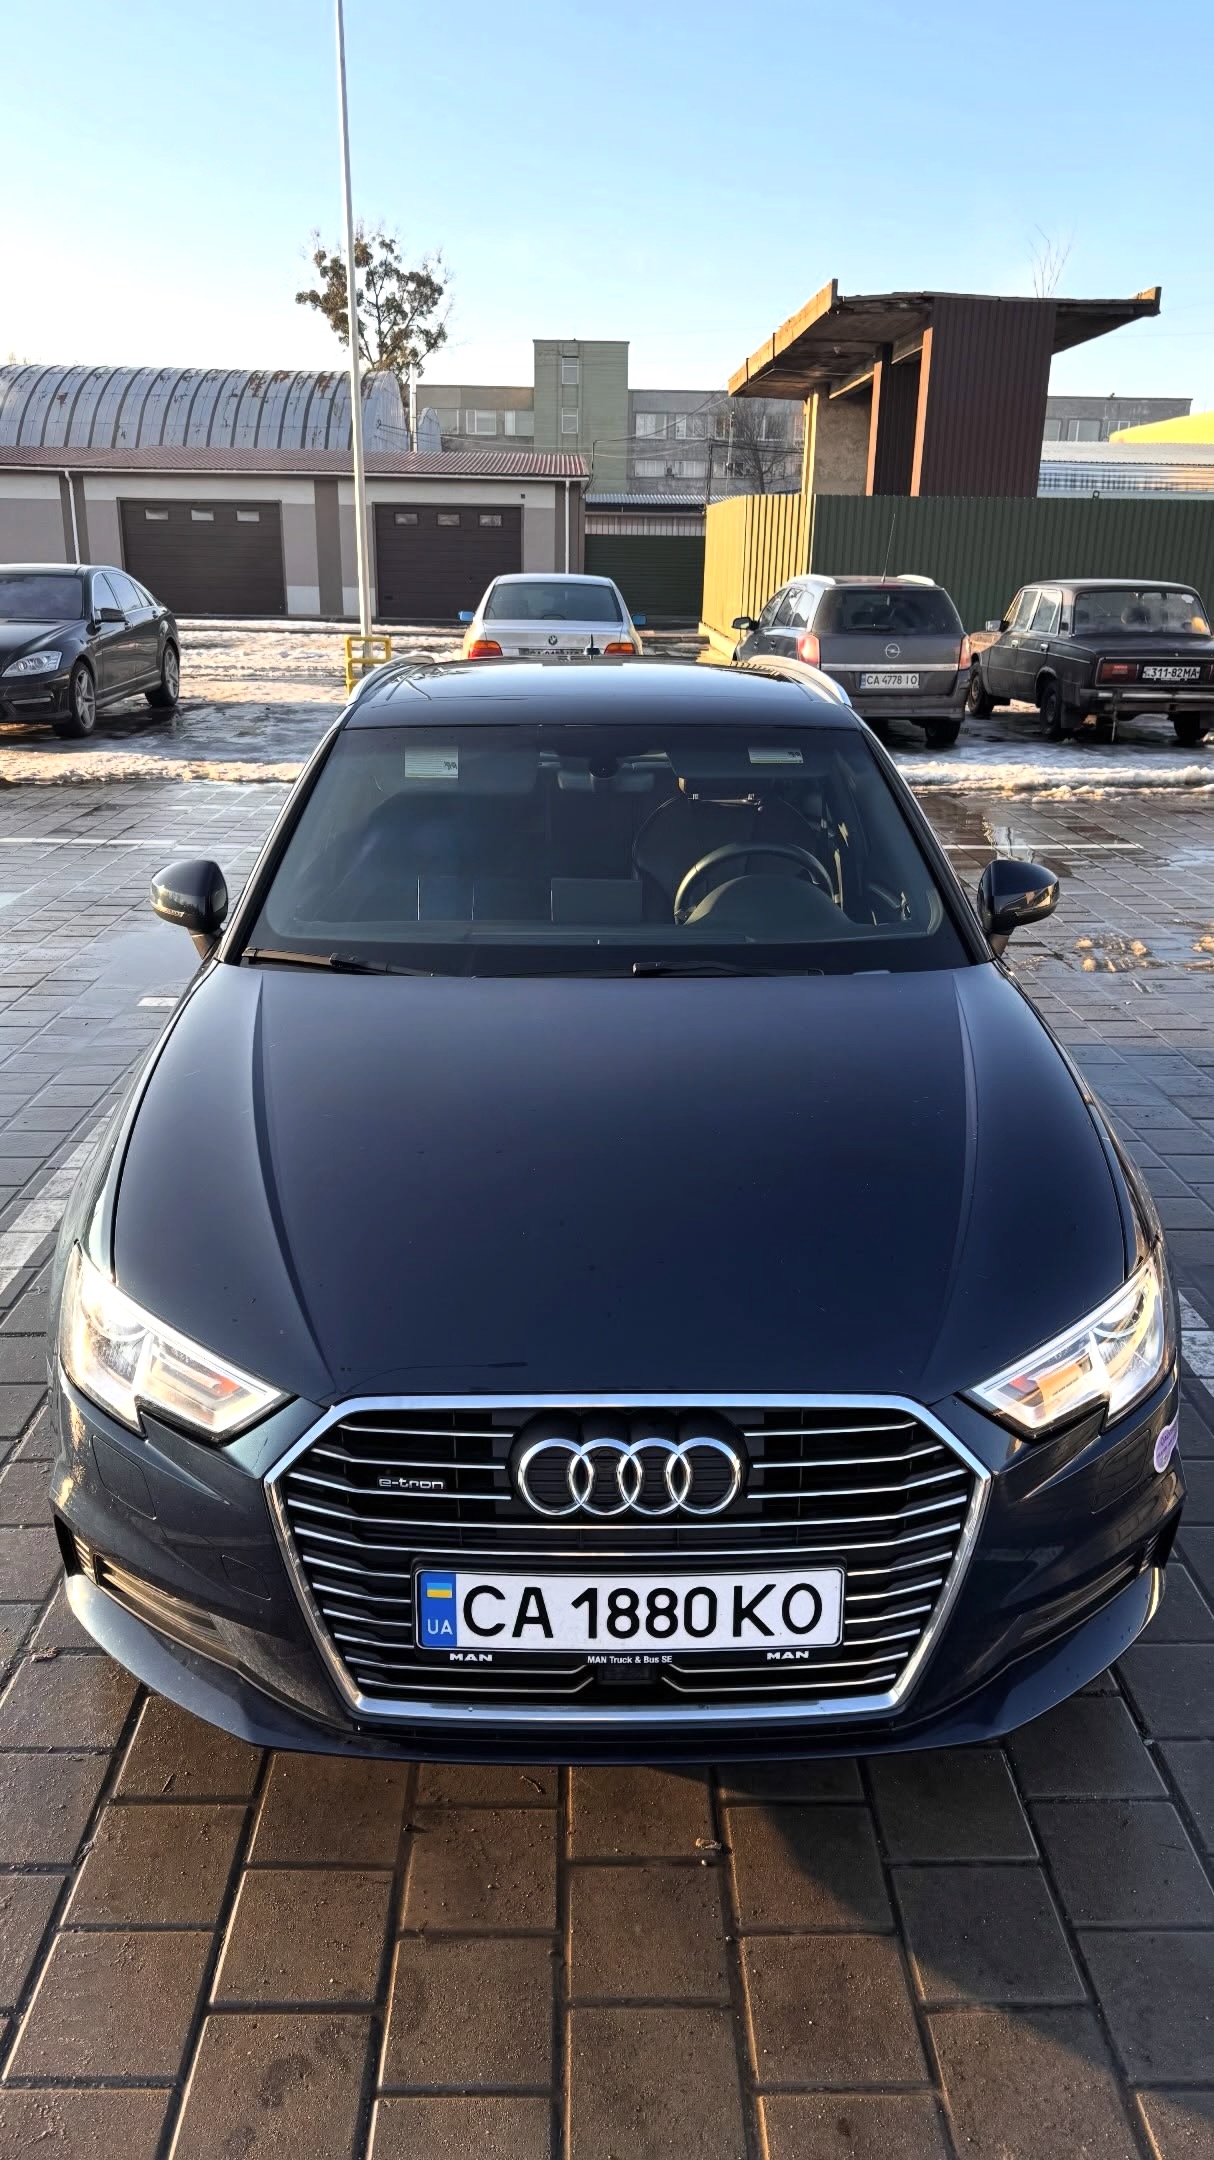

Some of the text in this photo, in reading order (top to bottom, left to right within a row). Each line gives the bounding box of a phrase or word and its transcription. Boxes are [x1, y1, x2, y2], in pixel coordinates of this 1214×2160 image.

[378, 1477, 444, 1490] e-tron
[463, 1582, 823, 1640] CA 1880 KO
[427, 1619, 453, 1635] UA
[449, 1653, 493, 1662] MAN
[587, 1655, 673, 1664] MAN Truck & Bus SE
[766, 1650, 810, 1660] MAN
